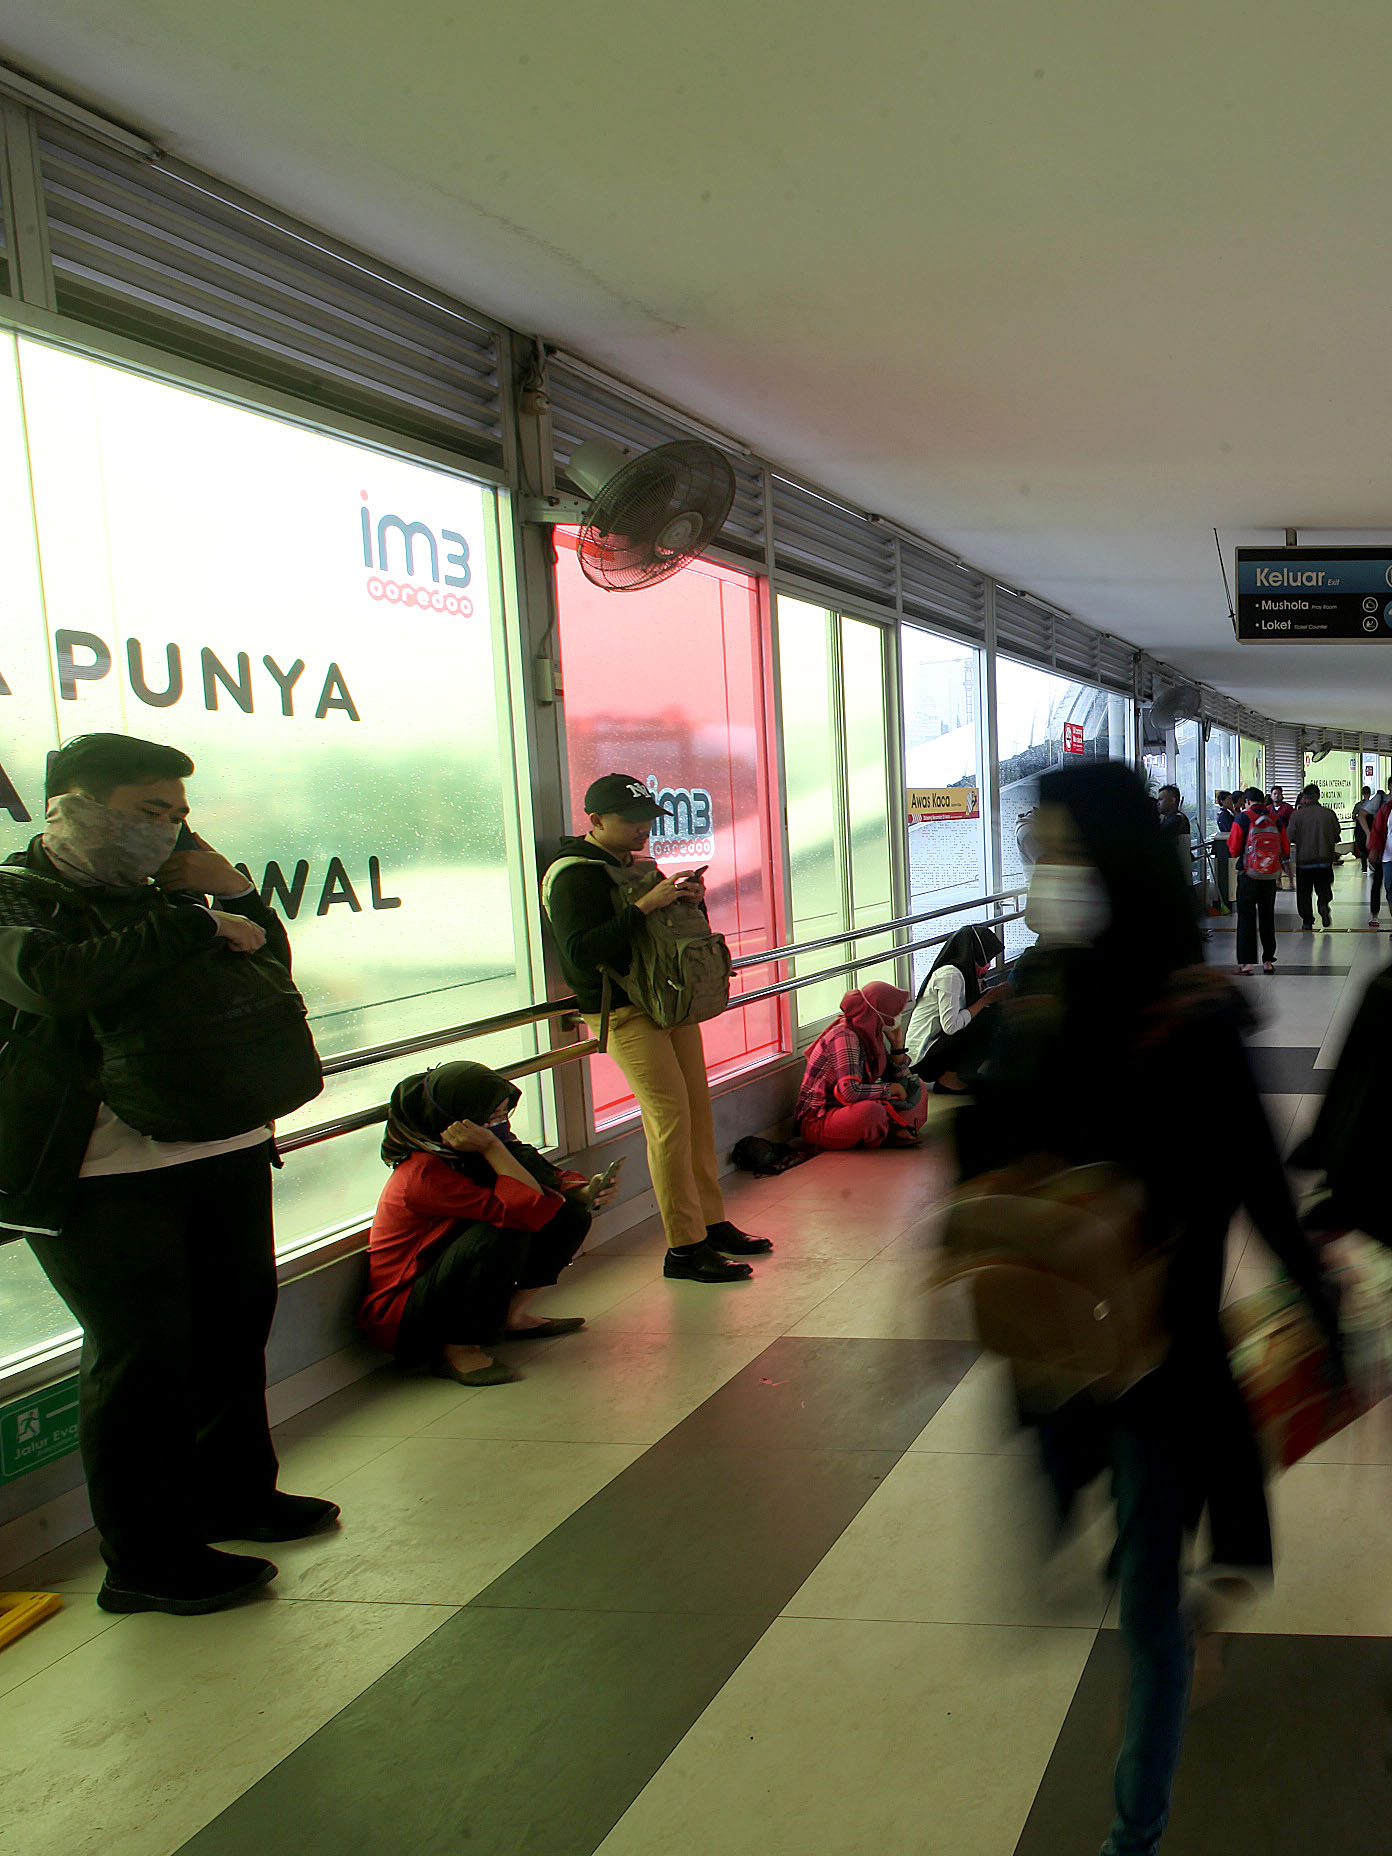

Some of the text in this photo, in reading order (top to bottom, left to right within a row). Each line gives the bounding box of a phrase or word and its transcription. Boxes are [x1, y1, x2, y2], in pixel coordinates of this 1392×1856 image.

[360, 489, 472, 589] im3
[1256, 567, 1326, 587] Keluar
[367, 576, 474, 618] ooredoo
[1261, 600, 1309, 610] Mushola
[1261, 620, 1291, 630] Loket
[55, 628, 361, 722] PUNYA
[911, 793, 951, 808] Awas Kaca
[654, 839, 711, 858] ooredoo
[14, 1439, 48, 1460] Jalur
